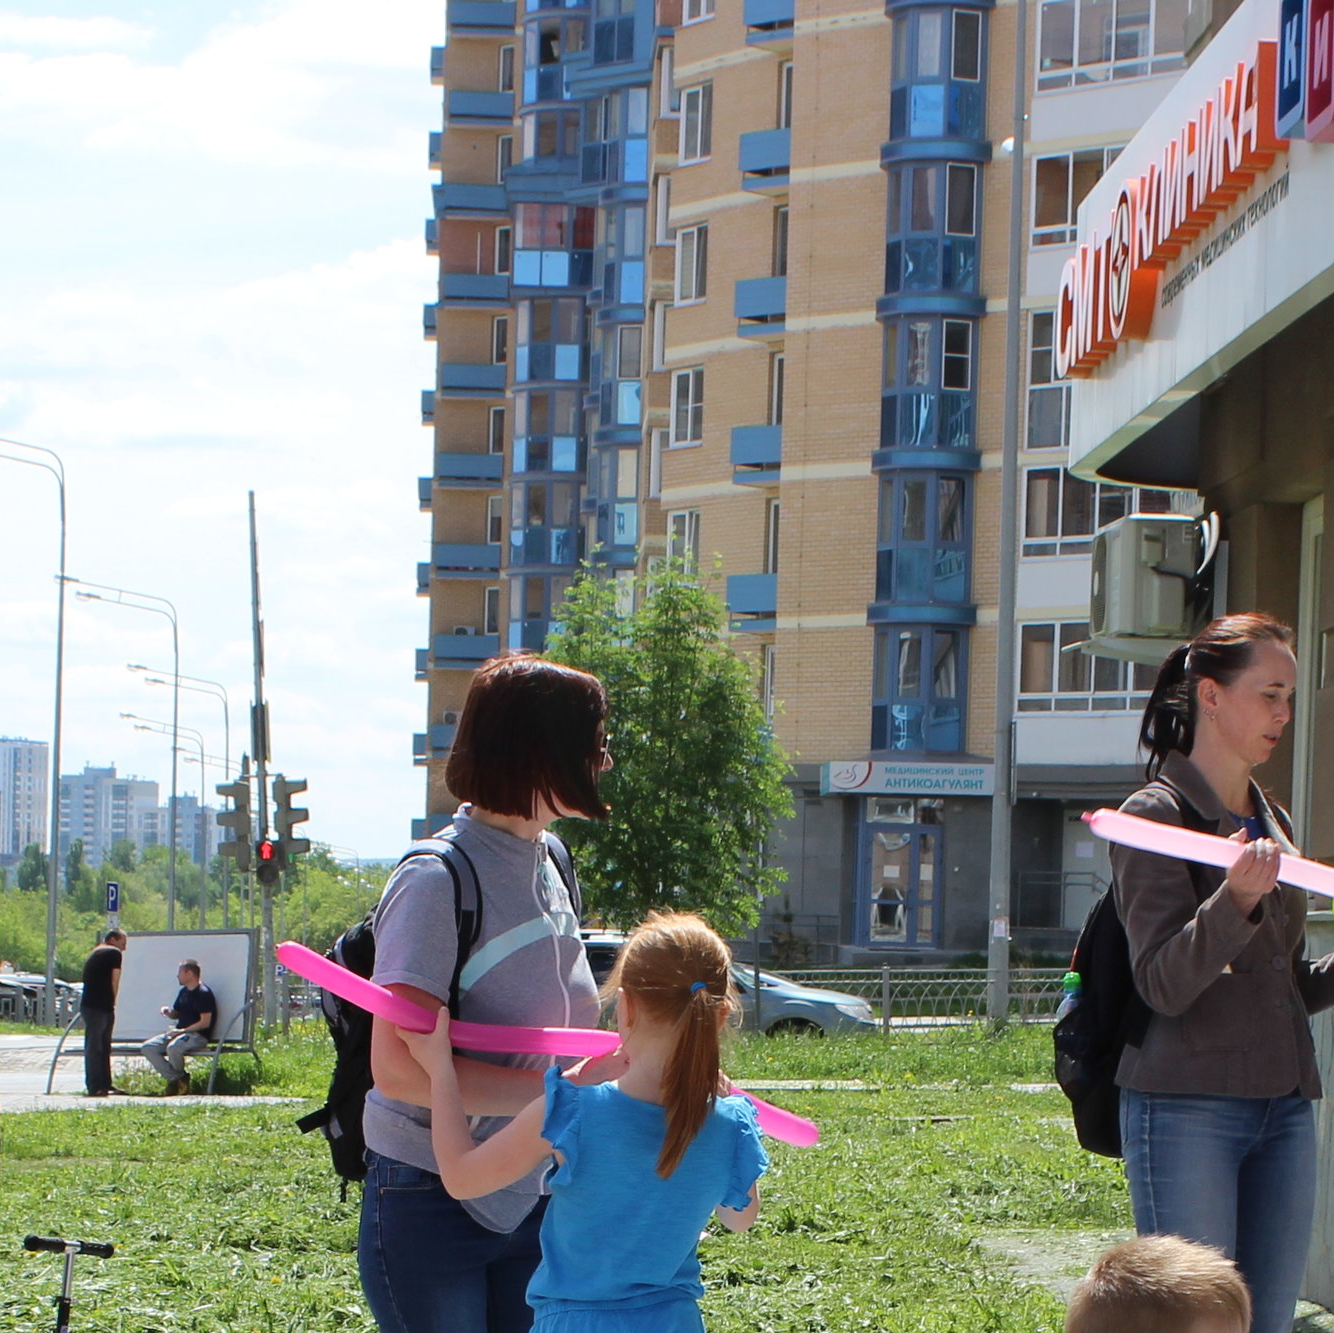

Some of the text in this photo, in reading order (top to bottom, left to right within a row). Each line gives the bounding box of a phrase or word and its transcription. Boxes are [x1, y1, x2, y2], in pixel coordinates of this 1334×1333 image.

[1131, 42, 1261, 271] КЛИНИКА
[884, 766, 985, 776] МЕДИЦИНСКИЙ ЦЕНТР
[884, 778, 984, 790] АНТИКОАГУЛЯНТ
